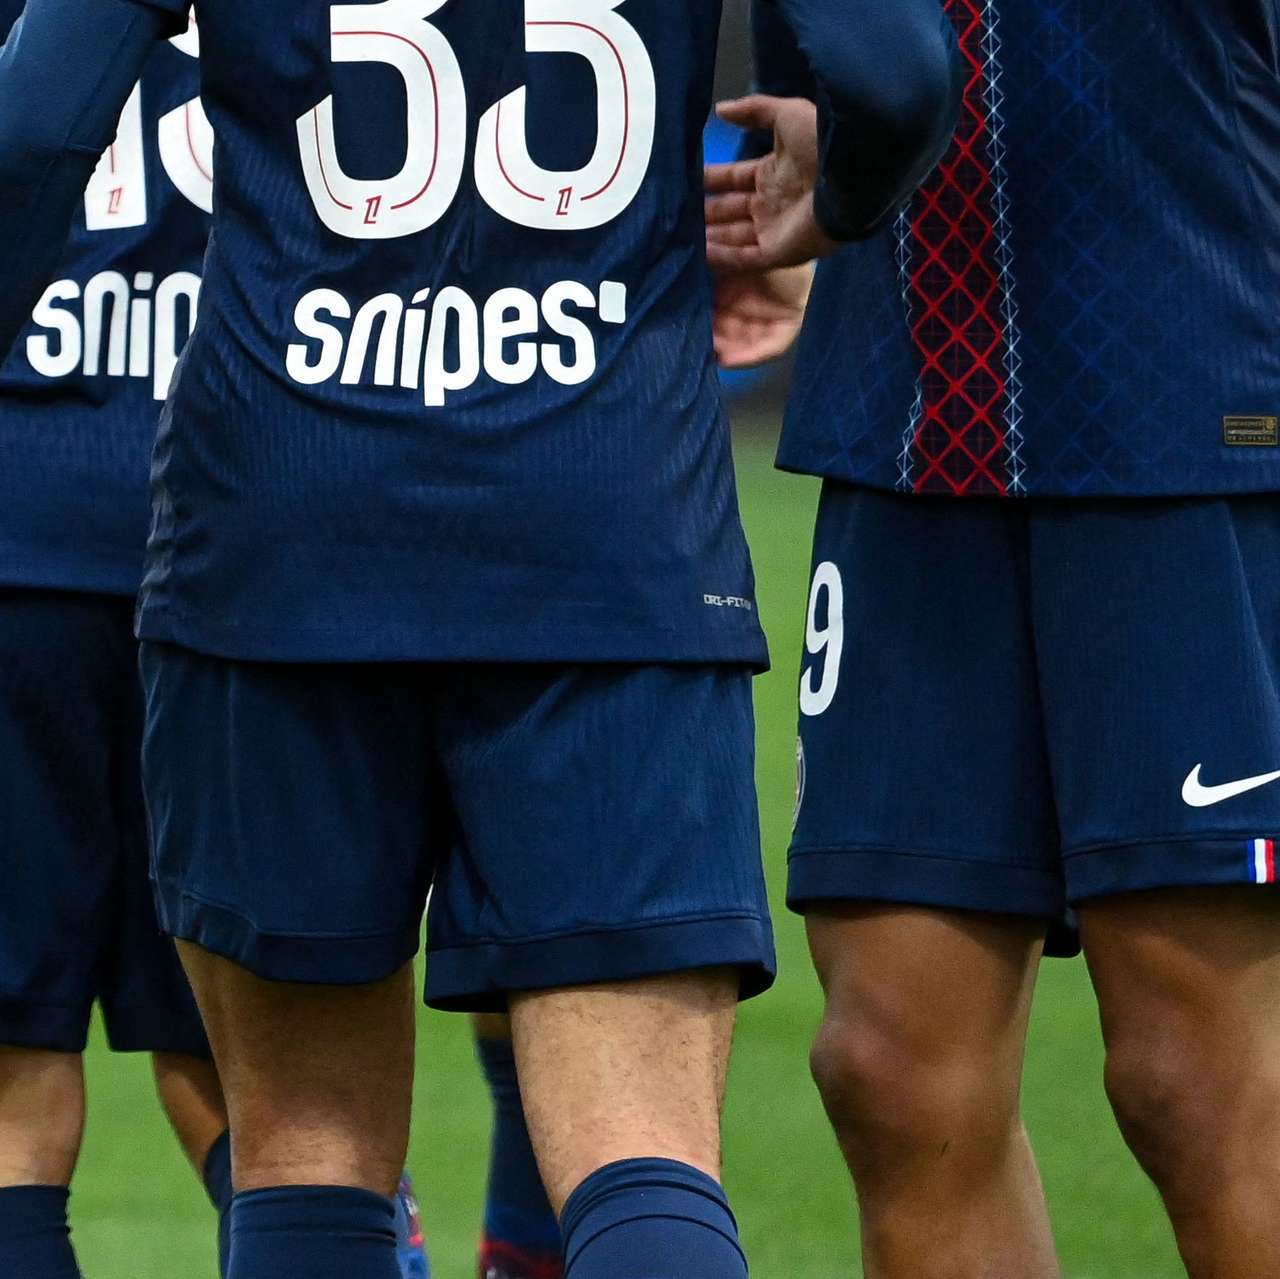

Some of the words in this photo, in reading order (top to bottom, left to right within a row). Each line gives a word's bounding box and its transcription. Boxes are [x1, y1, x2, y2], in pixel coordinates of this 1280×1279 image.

[26, 270, 203, 401] snip
[285, 280, 597, 407] snipes
[799, 561, 844, 716] 9
